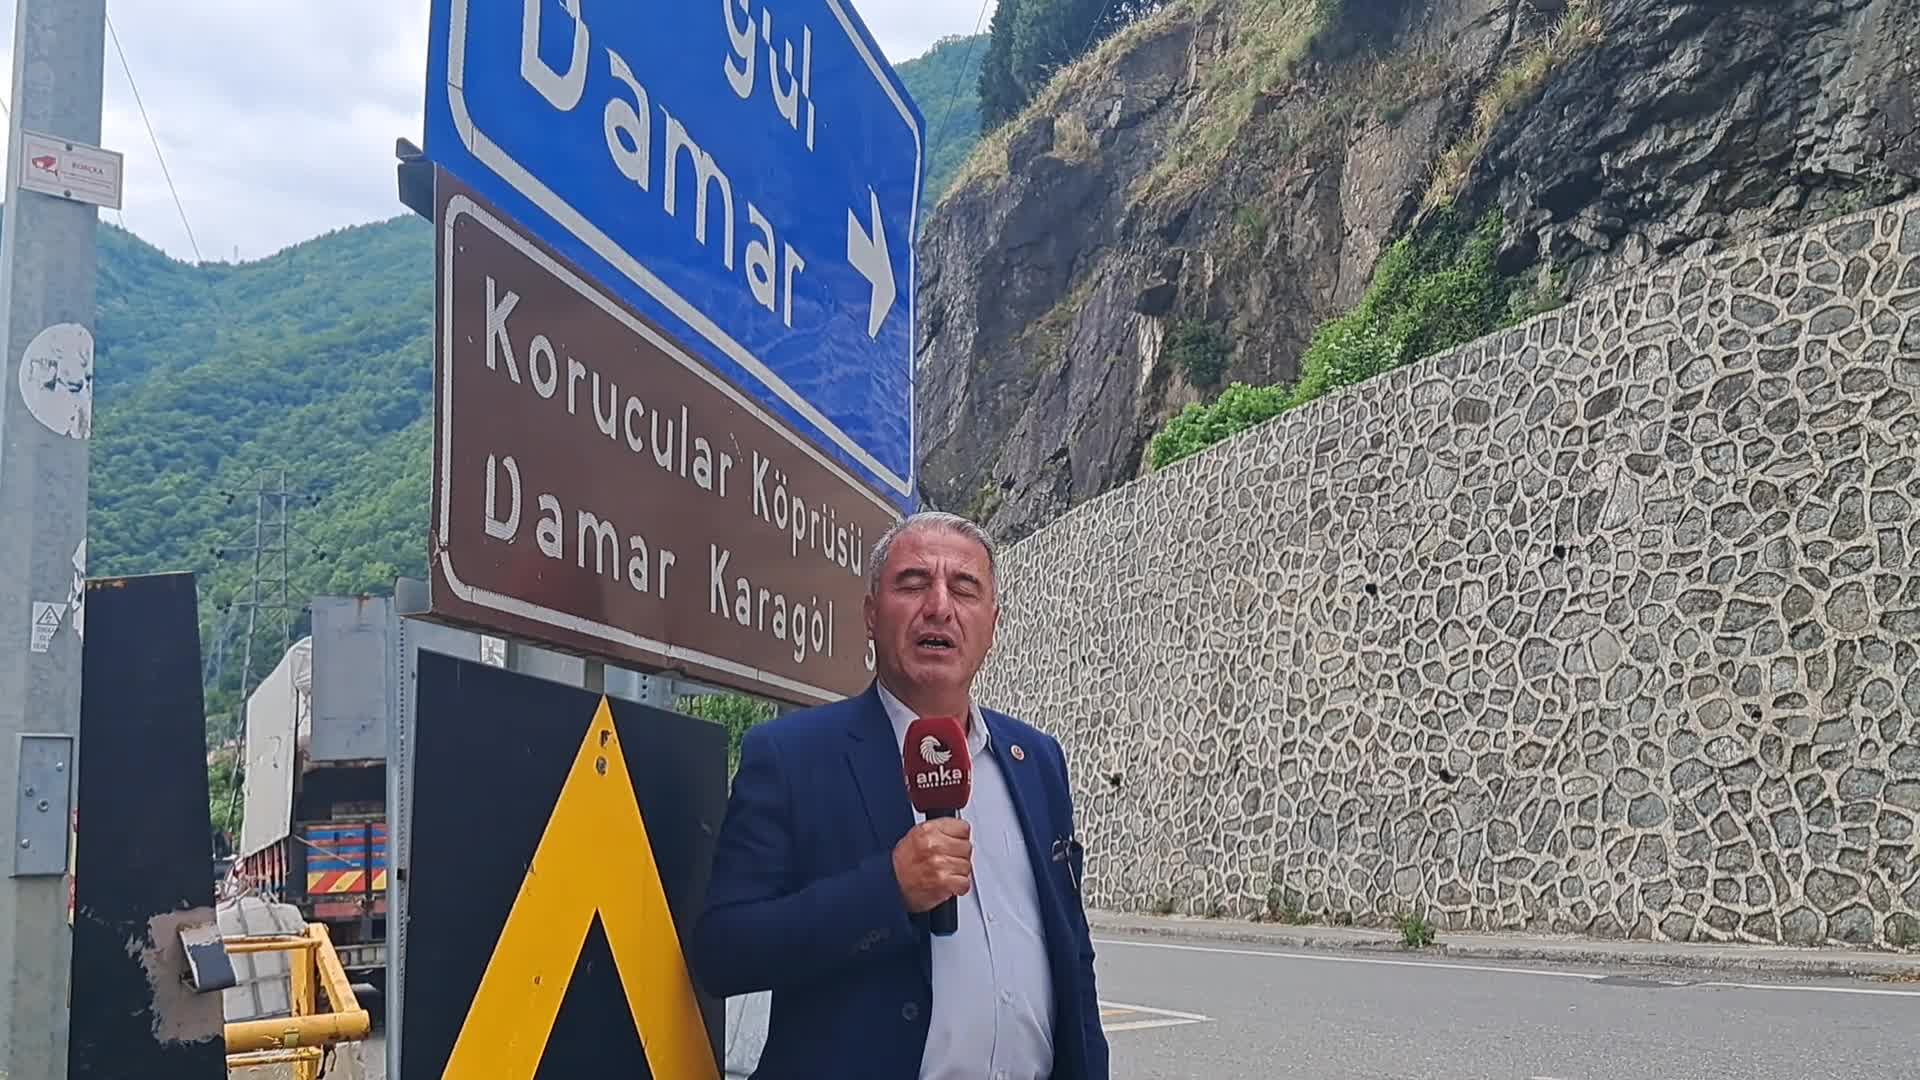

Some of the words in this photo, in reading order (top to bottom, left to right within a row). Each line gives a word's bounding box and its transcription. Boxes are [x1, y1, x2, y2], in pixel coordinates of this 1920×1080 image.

[520, 0, 804, 327] Damar
[485, 274, 733, 497] Korucular
[753, 450, 862, 577] Köprüsü
[485, 453, 677, 599] Damar
[916, 765, 962, 784] anka
